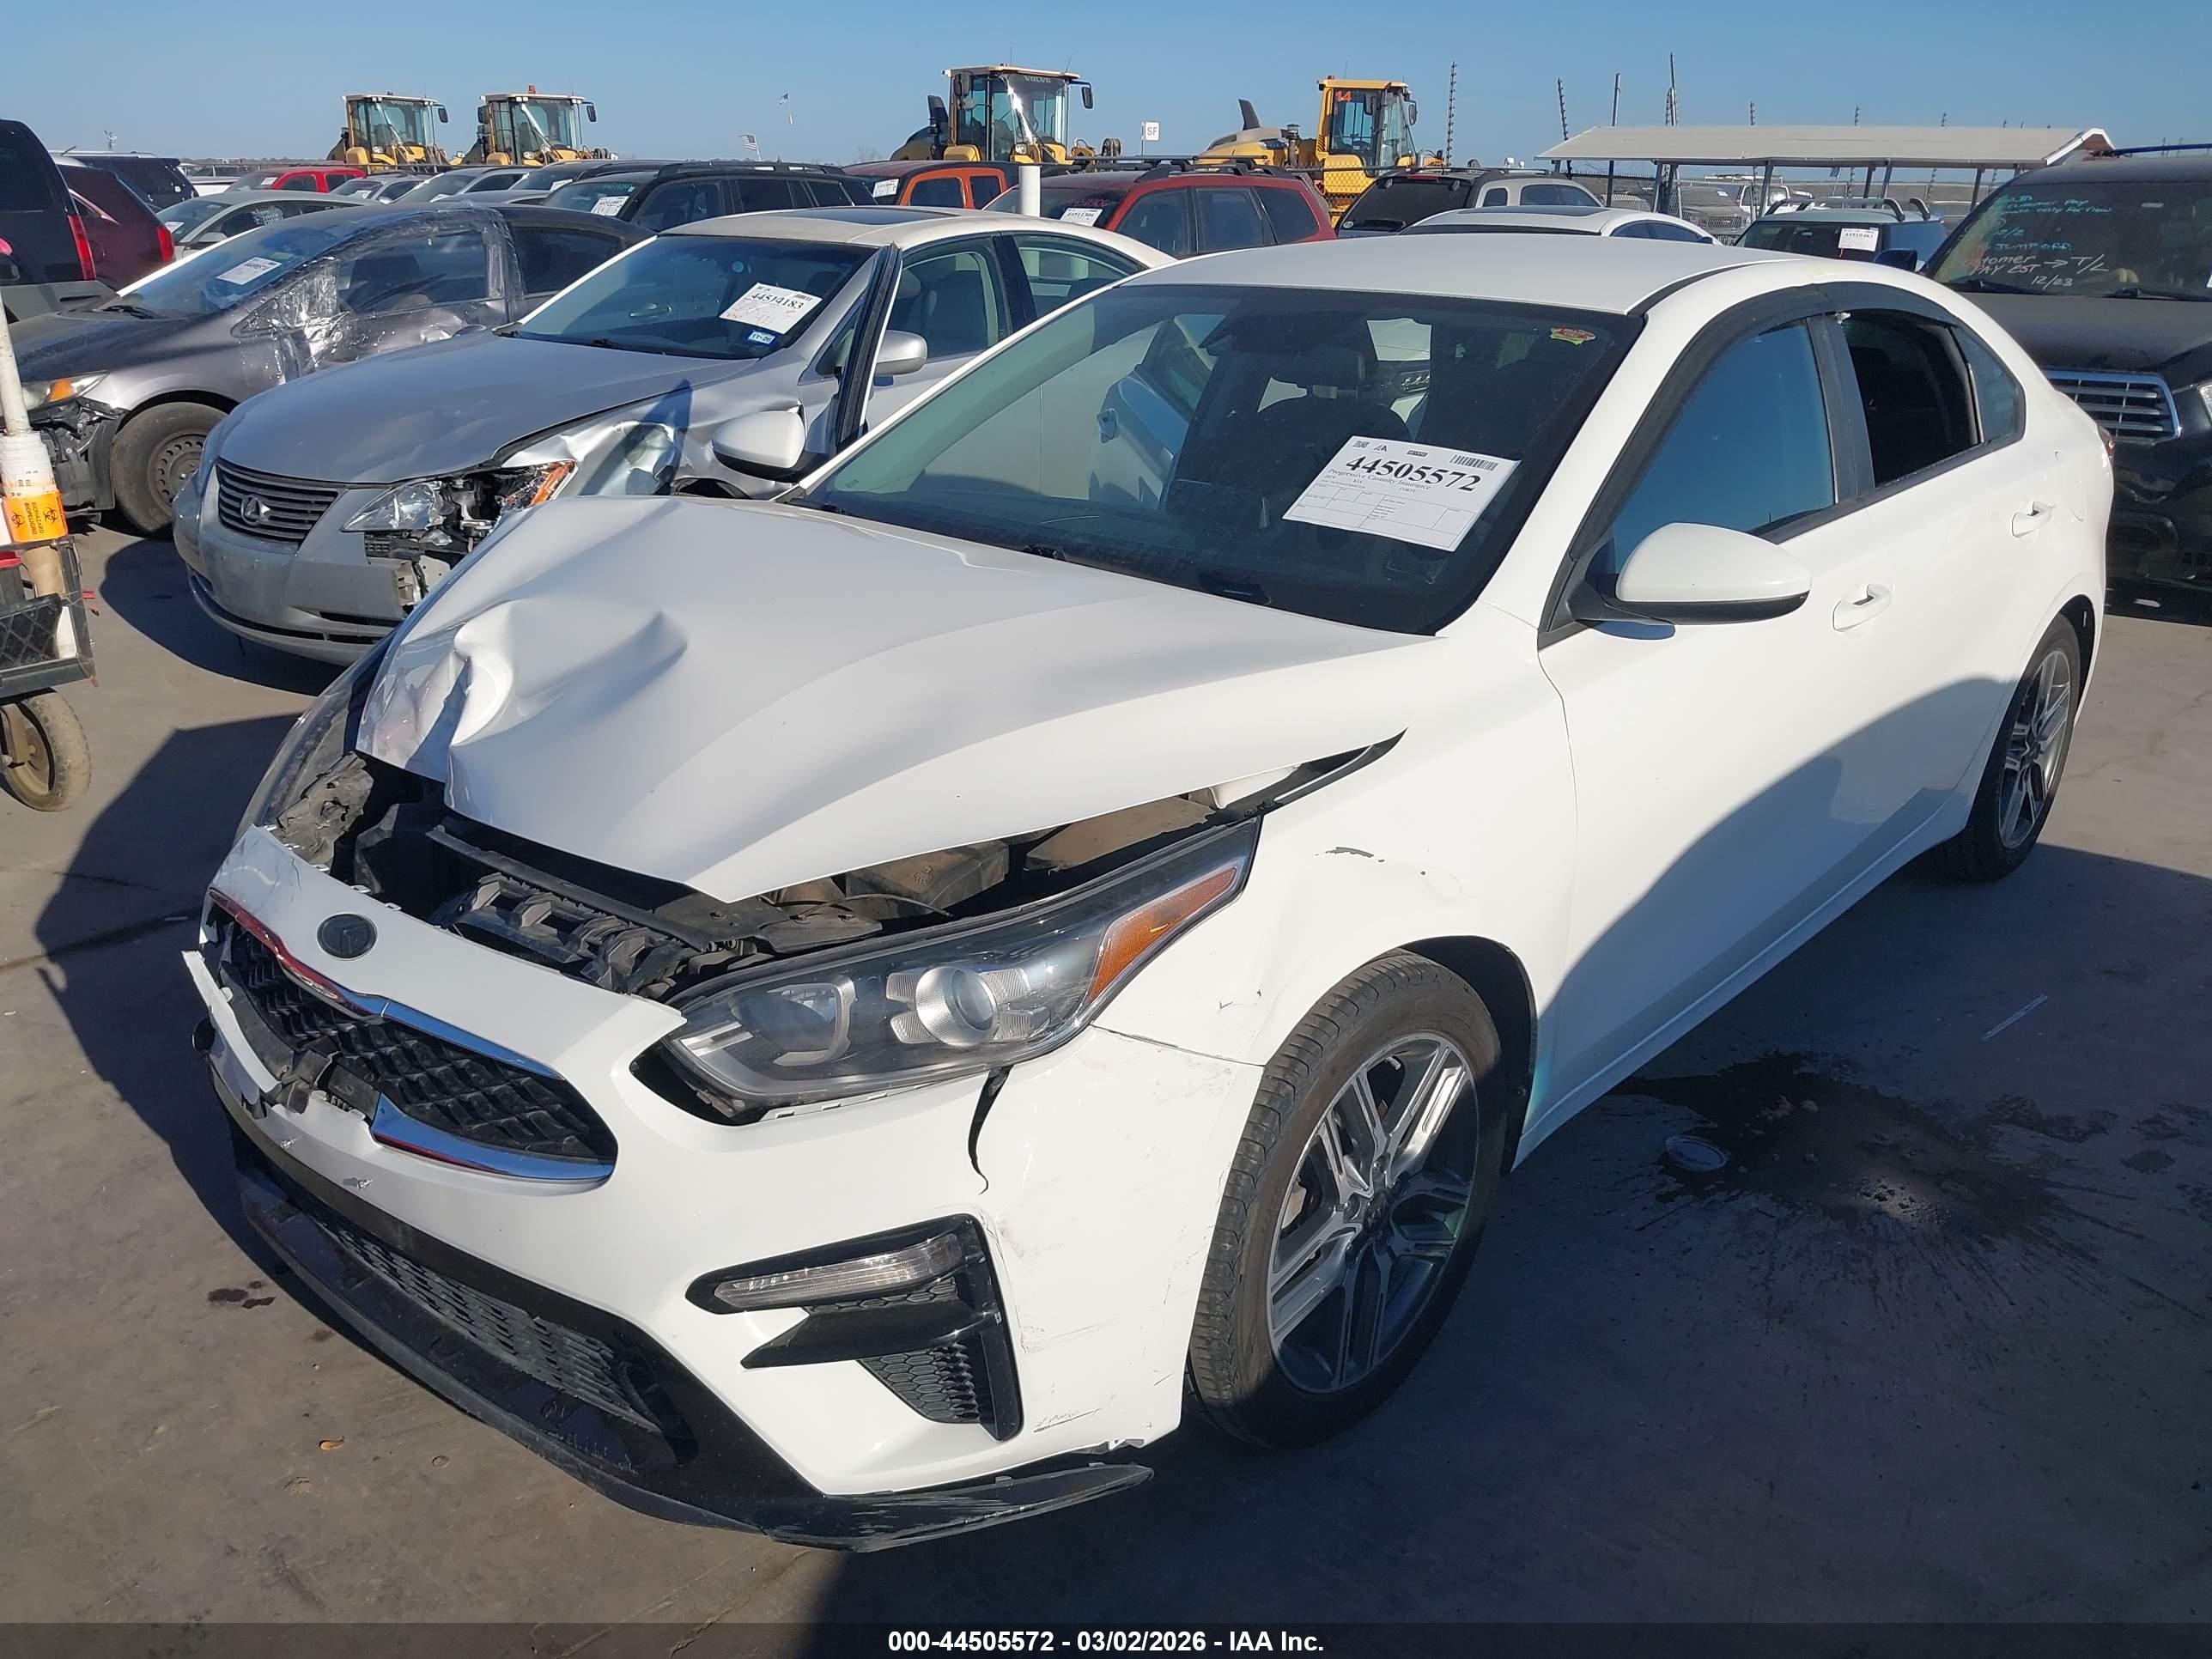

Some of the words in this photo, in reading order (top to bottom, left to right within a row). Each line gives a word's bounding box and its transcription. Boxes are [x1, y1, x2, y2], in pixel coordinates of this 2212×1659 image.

[1147, 126, 1158, 136] SF
[751, 292, 805, 310] 44514183
[1328, 468, 1367, 479] Progressive
[1368, 475, 1395, 484] Casualty
[1396, 479, 1431, 490] Insurance
[1346, 456, 1481, 492] 44505572
[31, 501, 45, 534] BIOHAZARD
